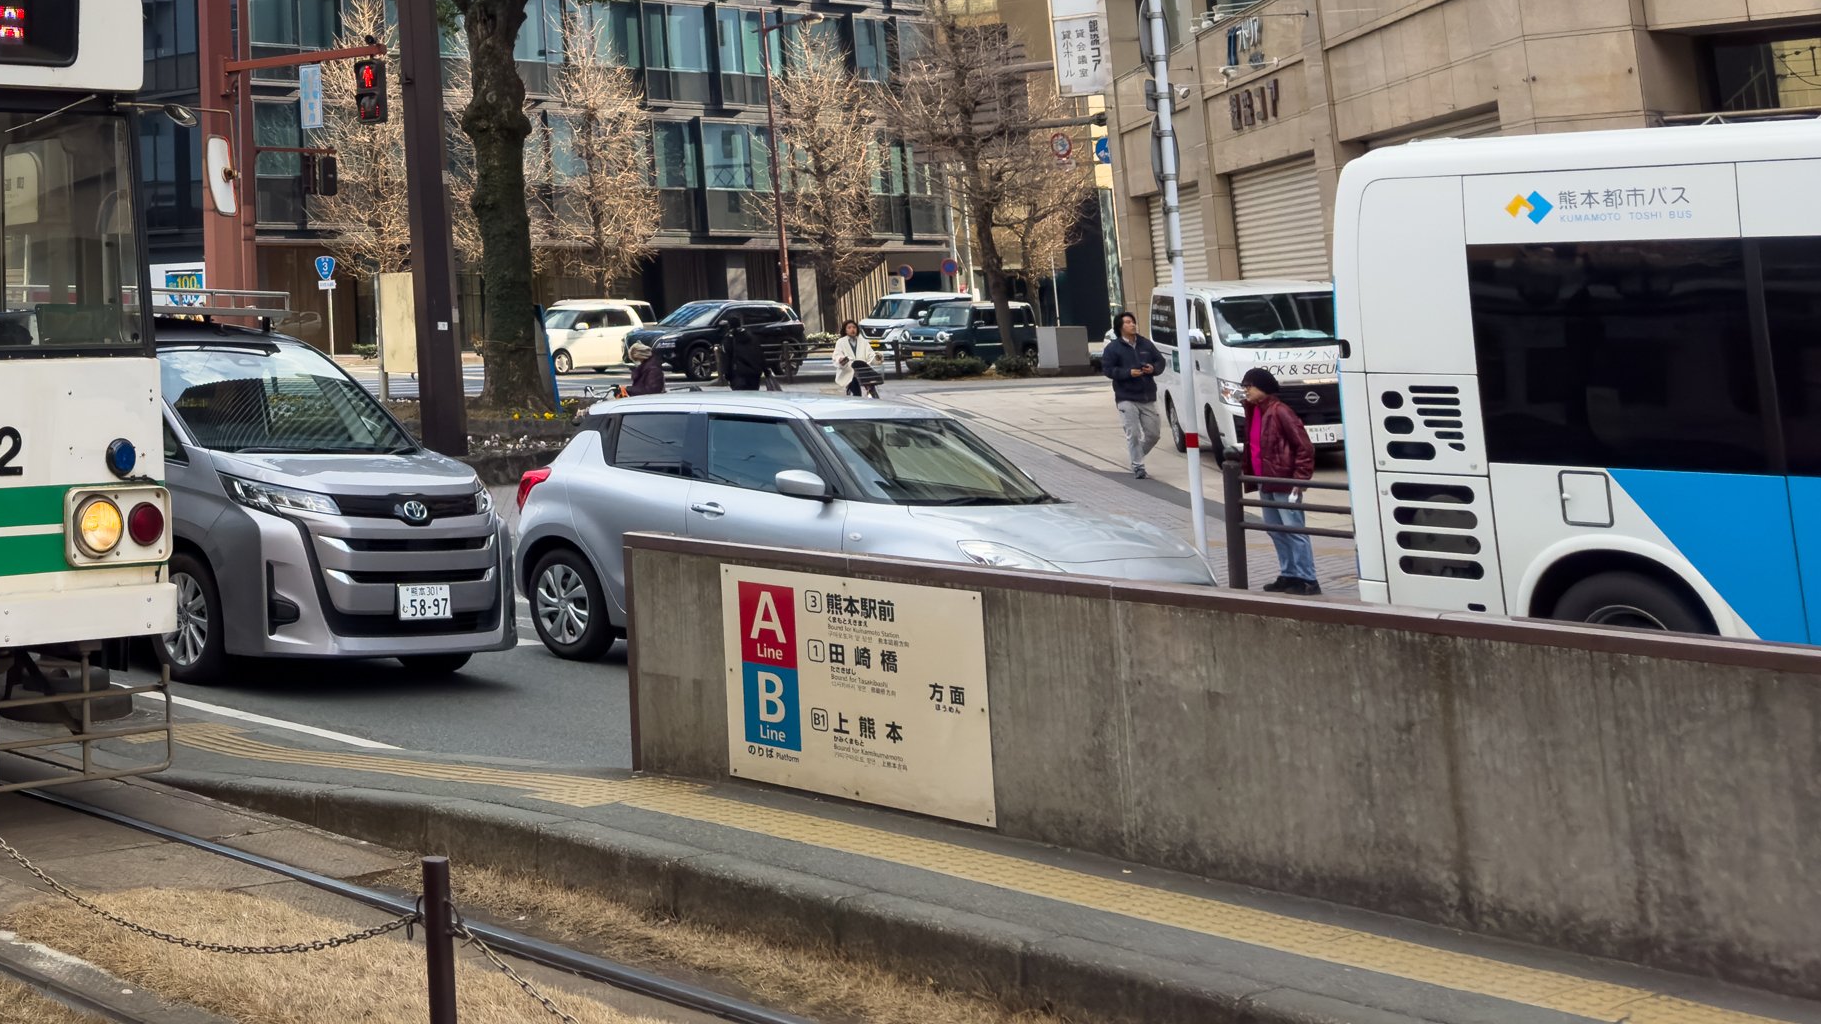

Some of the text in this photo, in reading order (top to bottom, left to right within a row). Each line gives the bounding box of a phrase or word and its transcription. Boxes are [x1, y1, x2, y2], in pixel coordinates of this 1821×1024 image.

[1558, 186, 1690, 210] 熊本都市バス
[1560, 210, 1693, 223] KUMAMOTO TOSHI BUS
[322, 261, 329, 272] 3
[1278, 349, 1317, 360] ロック
[1288, 364, 1298, 376] &
[410, 598, 448, 617] 58-97
[749, 590, 787, 644] A
[810, 592, 895, 623] 3 熊本駅前
[757, 643, 784, 661] Line
[812, 642, 898, 674] 1 田崎橋
[757, 670, 786, 724] B
[928, 682, 965, 707] 方面
[935, 704, 961, 715] ほうめん
[759, 724, 786, 743] Line
[813, 712, 903, 744] B1 上熊本
[748, 744, 800, 763] のりば Platform
